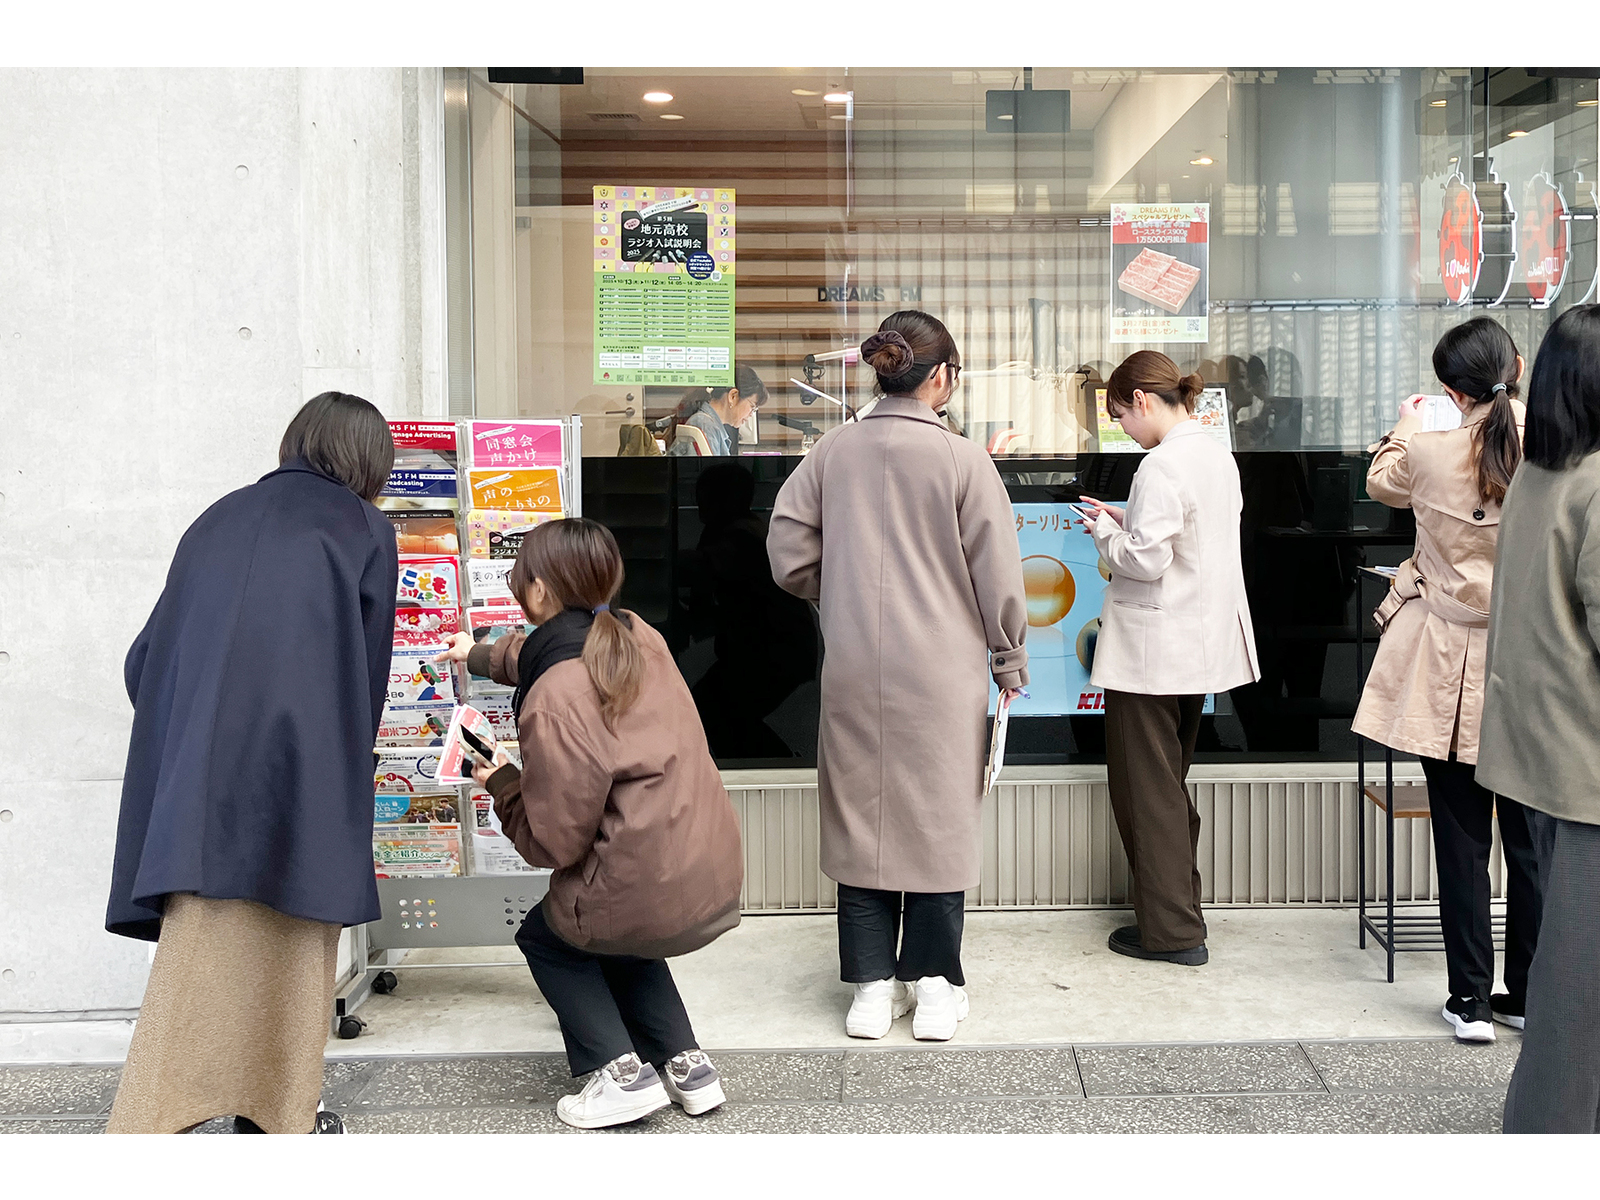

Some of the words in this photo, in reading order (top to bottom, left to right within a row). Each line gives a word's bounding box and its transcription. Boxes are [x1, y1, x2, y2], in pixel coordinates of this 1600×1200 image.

[640, 223, 689, 237] 地元高校
[1132, 229, 1188, 237] ローススライス900g
[627, 238, 702, 249] ラジオ入試説明会
[1445, 262, 1450, 277] I
[1456, 259, 1471, 278] Radi
[818, 286, 885, 302] DREAMS
[900, 286, 922, 302] FM
[414, 432, 452, 440] Advertising
[485, 434, 534, 452] 同窓会
[489, 448, 538, 466] 声かけ
[404, 472, 418, 480] FM
[481, 487, 513, 504] 声の
[402, 570, 447, 595] こども
[1077, 693, 1105, 710] KI
